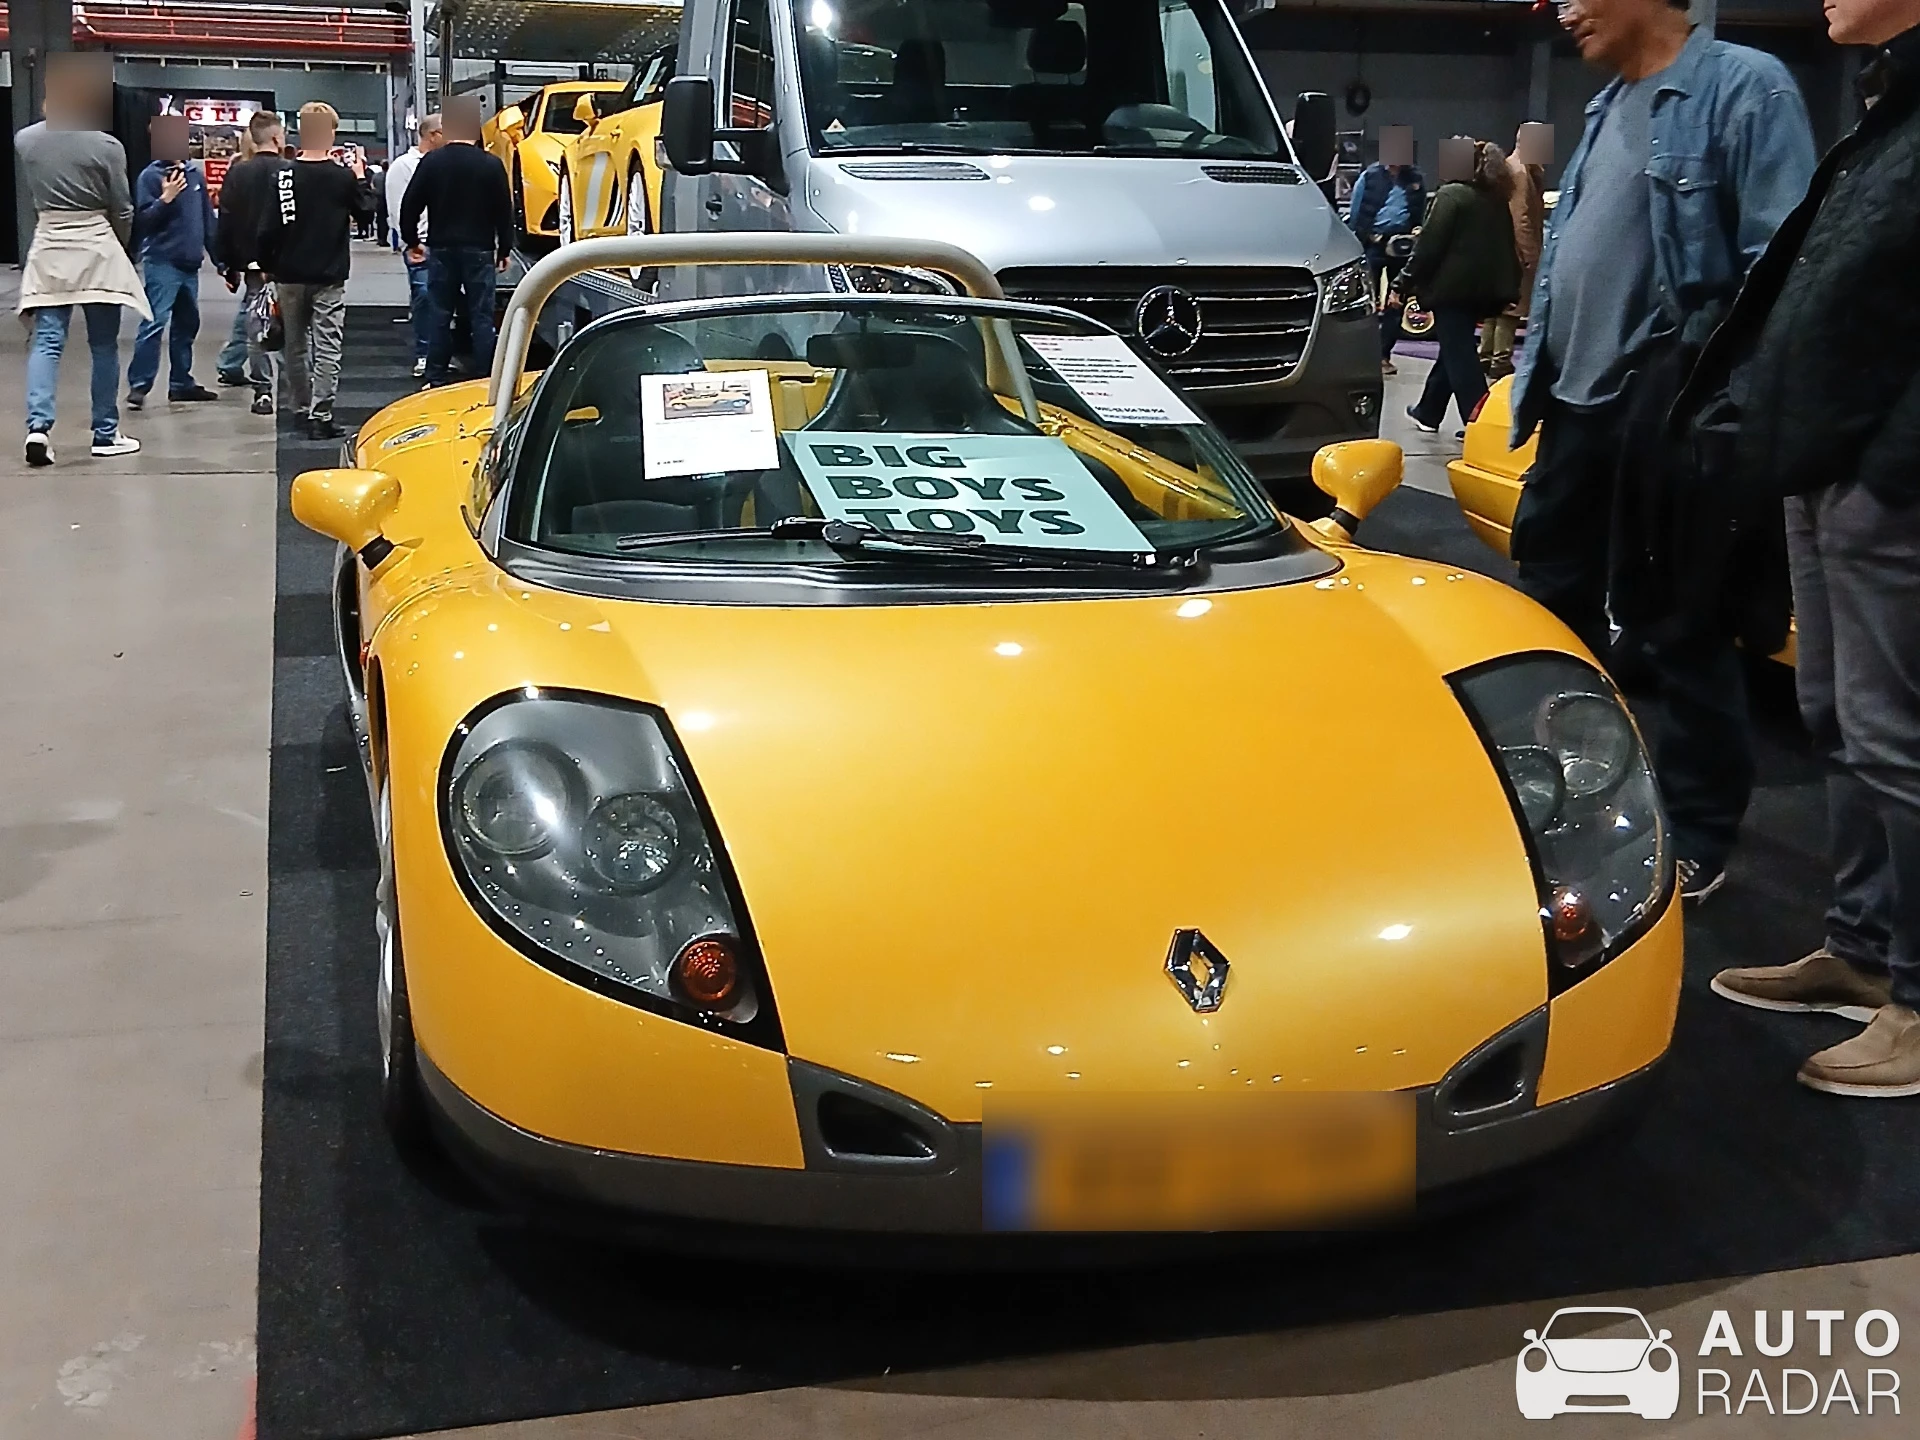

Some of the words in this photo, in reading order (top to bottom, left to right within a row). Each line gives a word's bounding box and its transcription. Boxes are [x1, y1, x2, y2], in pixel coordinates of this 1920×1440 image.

[278, 169, 296, 225] TRUST
[809, 444, 967, 468] BIG
[826, 476, 1066, 501] BOYS
[845, 508, 1086, 535] TOYS
